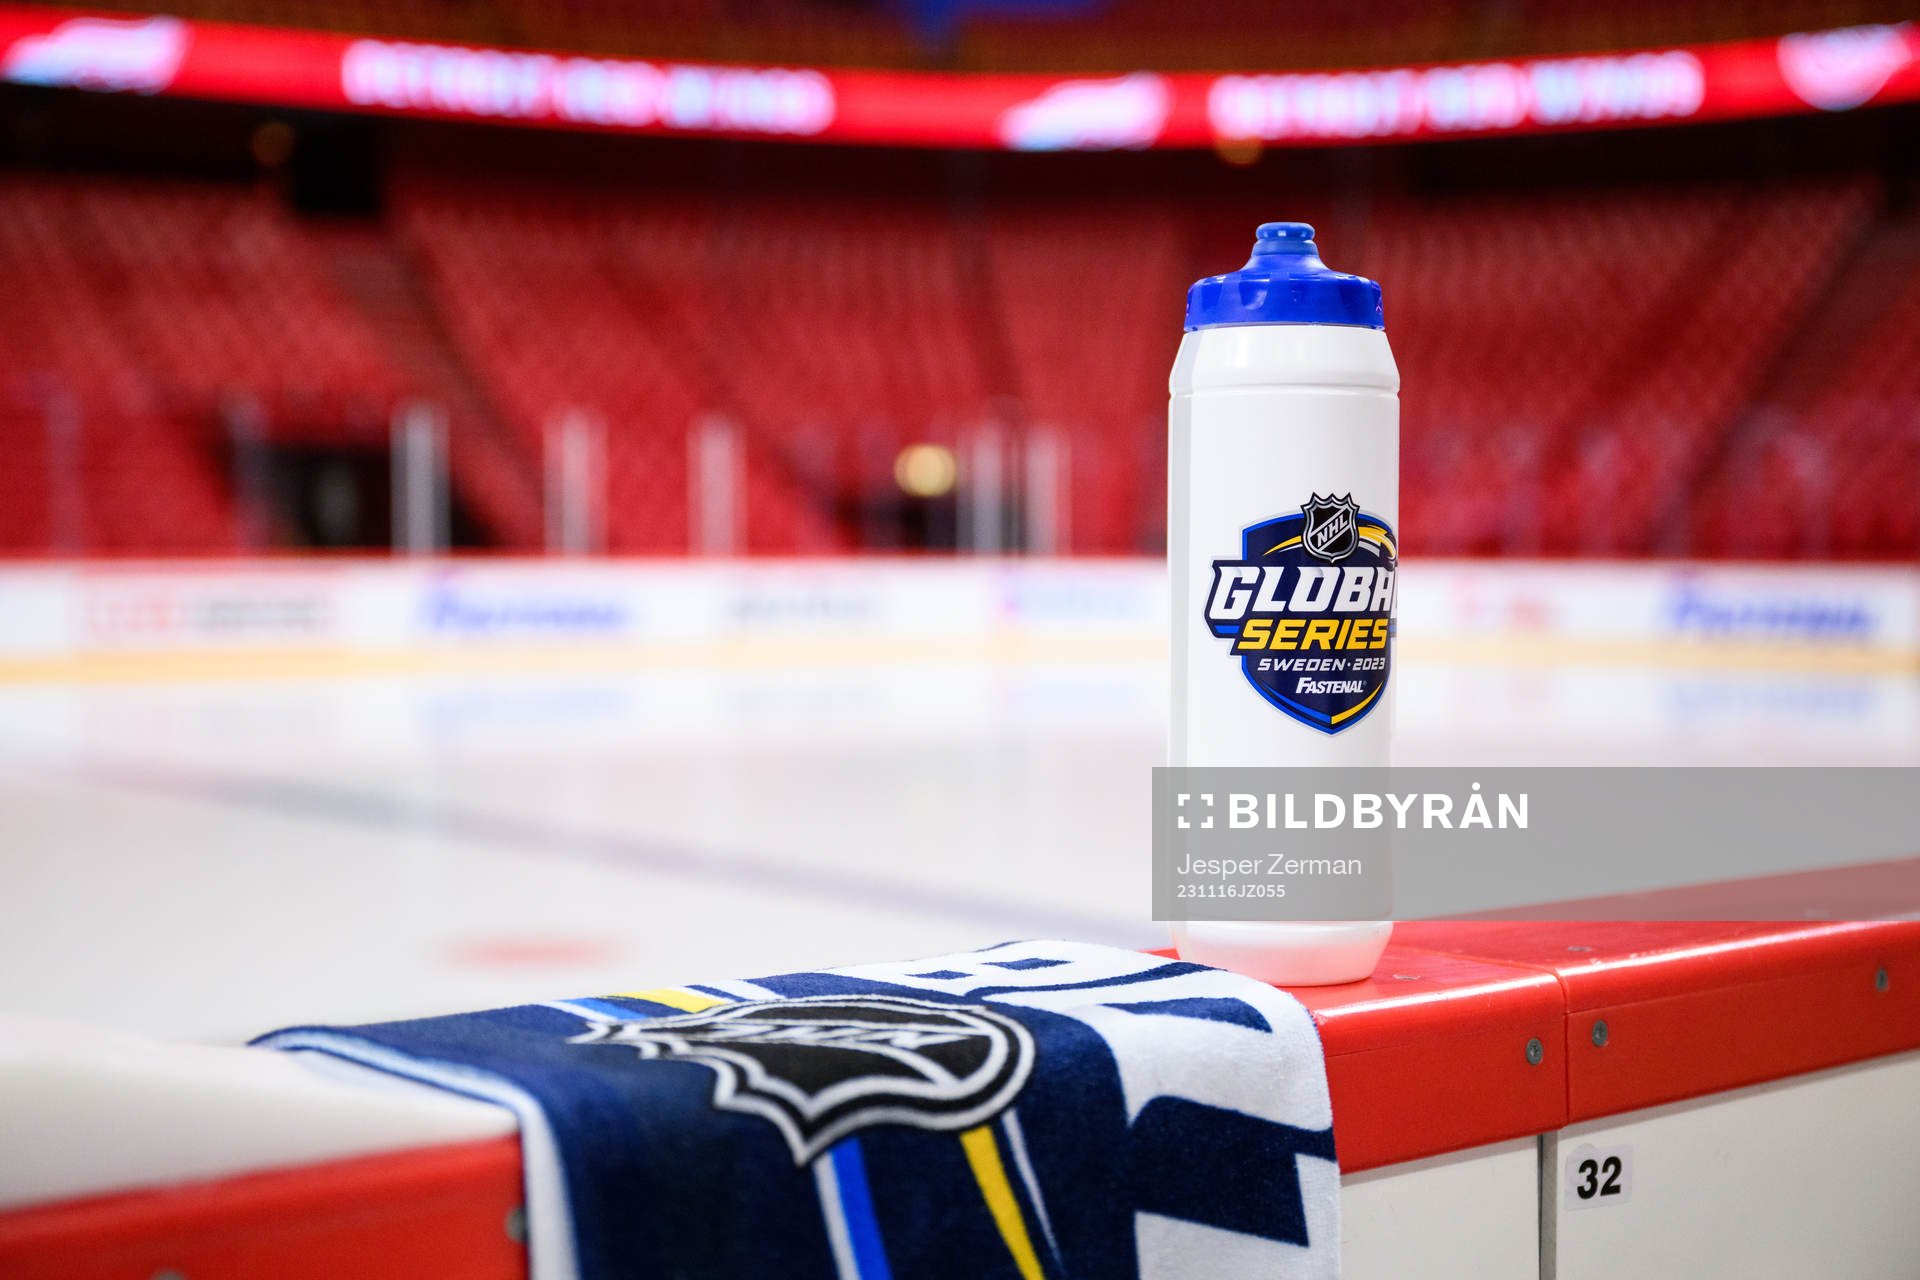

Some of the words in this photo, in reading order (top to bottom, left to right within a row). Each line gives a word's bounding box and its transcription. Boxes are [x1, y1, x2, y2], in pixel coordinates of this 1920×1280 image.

[1316, 513, 1348, 548] NHL
[1208, 565, 1398, 620] GLOBA
[1237, 618, 1389, 651] SERIES
[1576, 1155, 1623, 1200] 32
